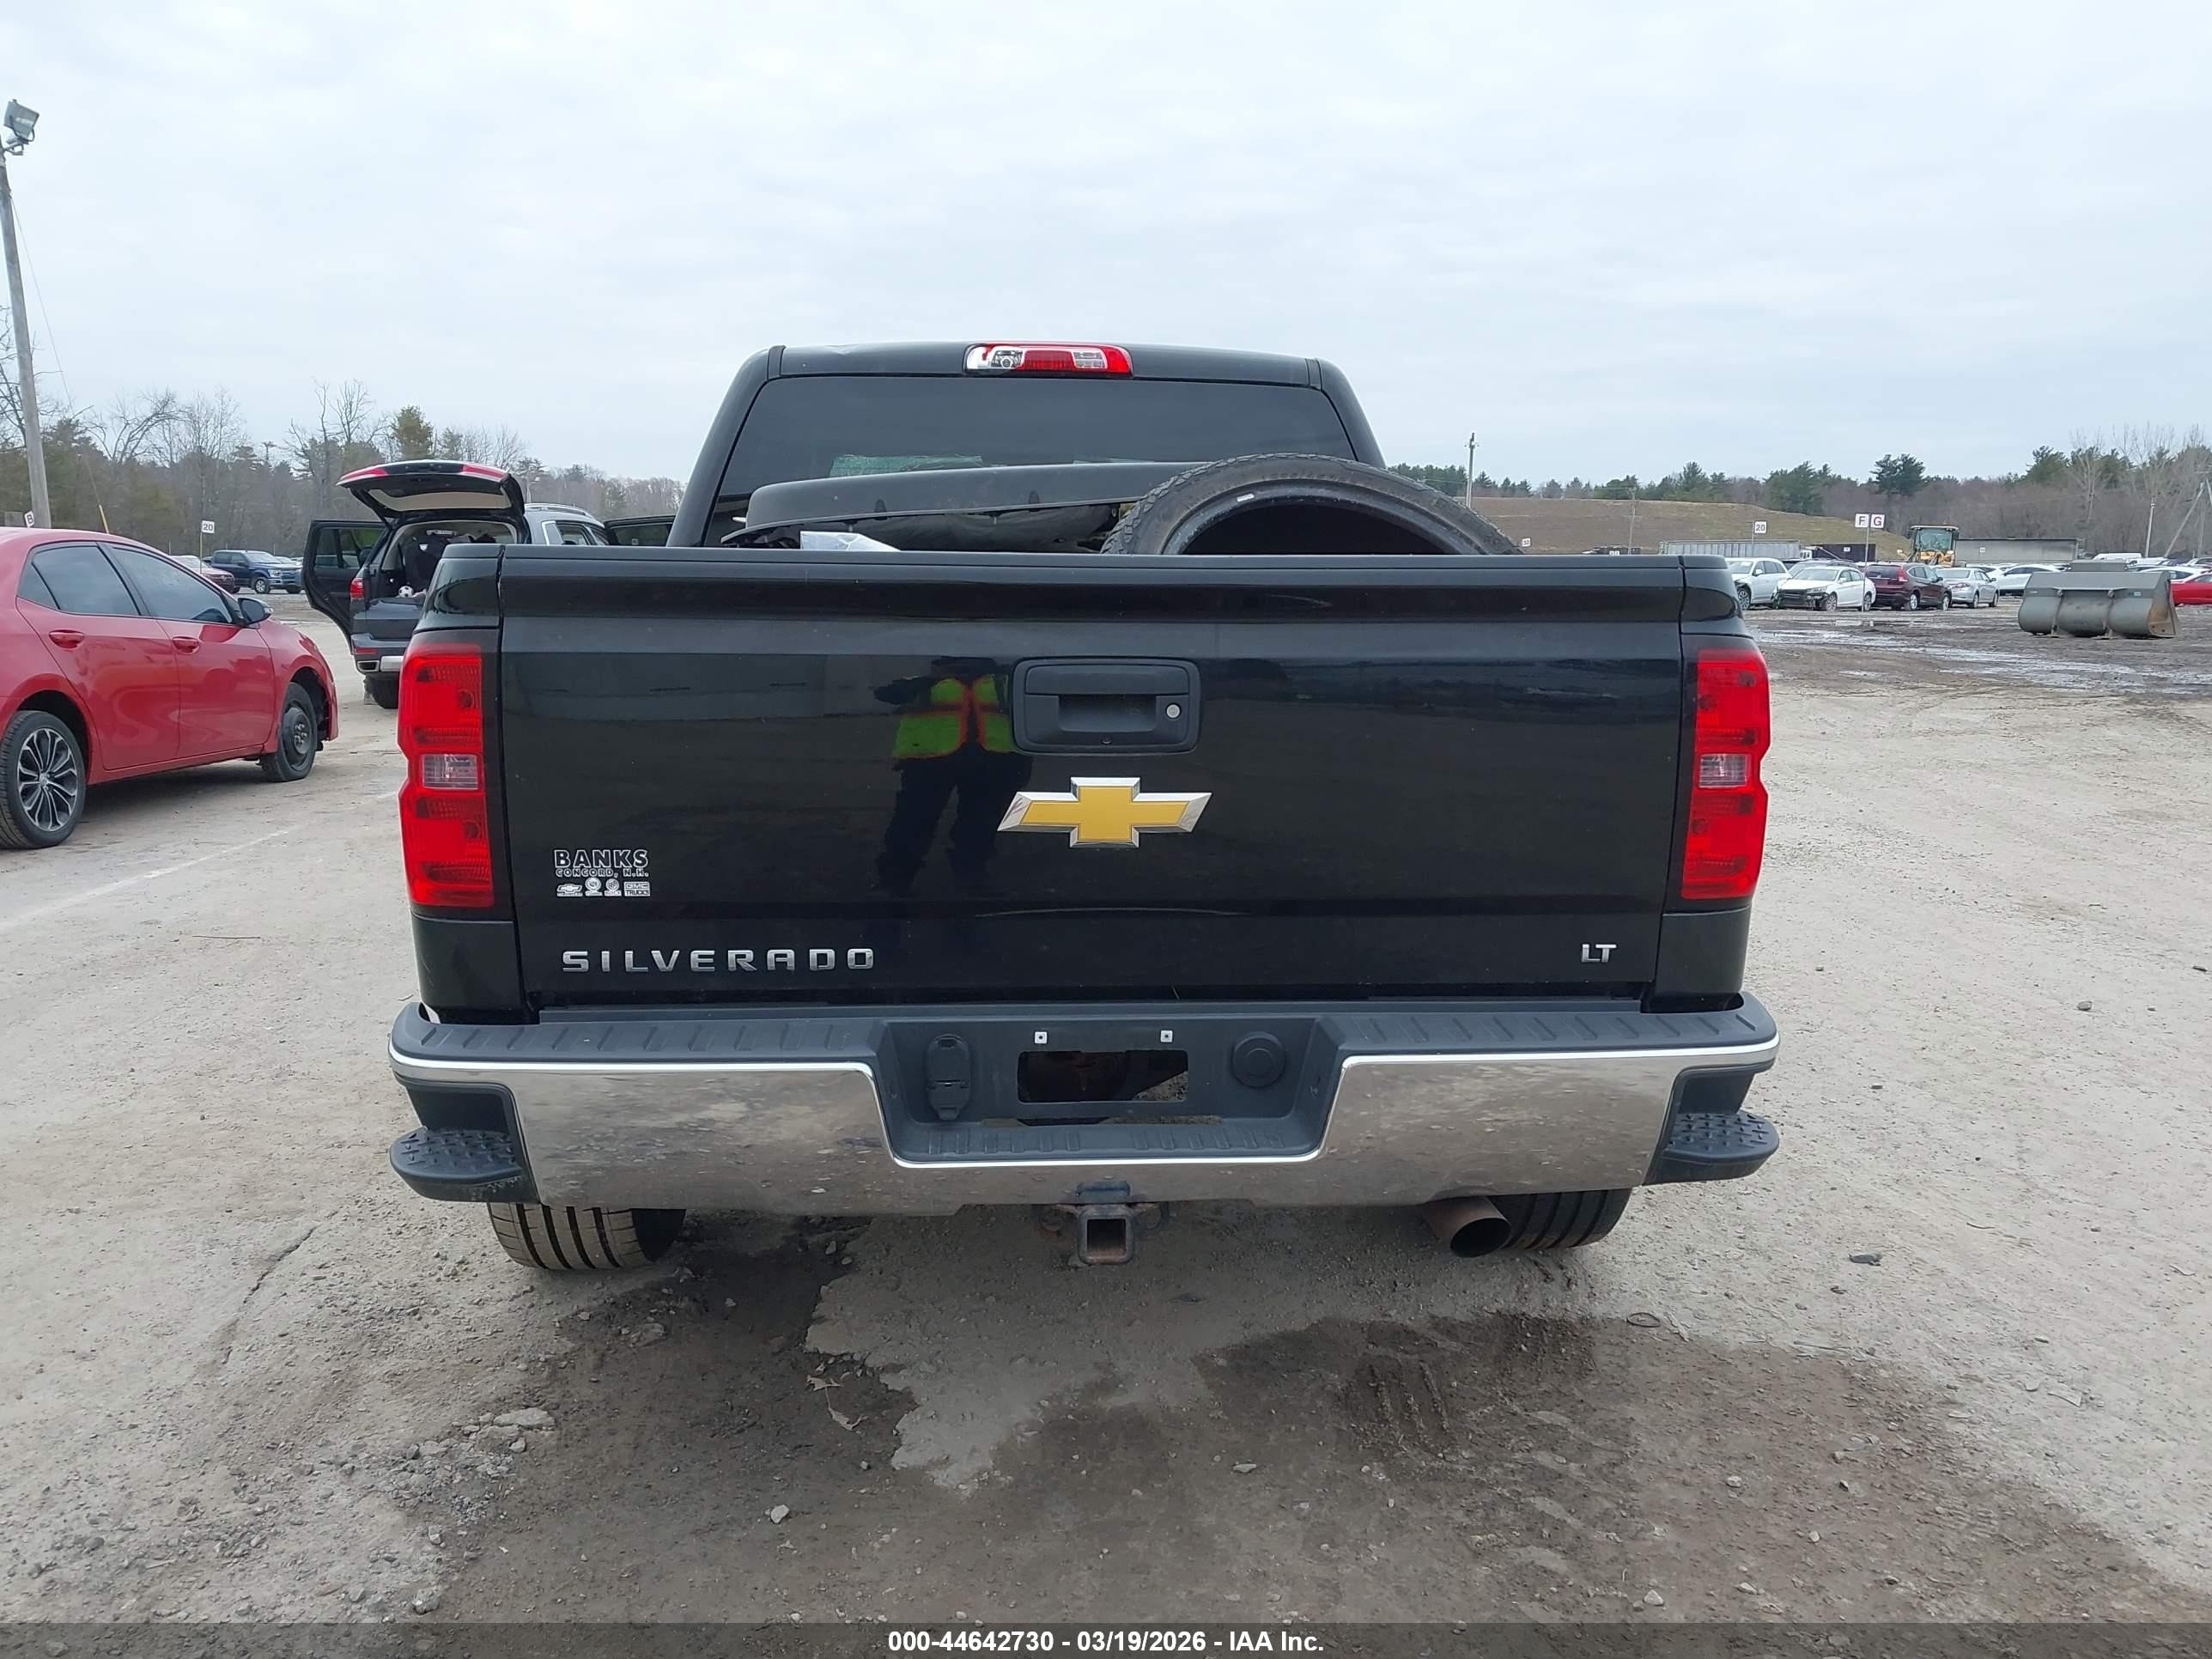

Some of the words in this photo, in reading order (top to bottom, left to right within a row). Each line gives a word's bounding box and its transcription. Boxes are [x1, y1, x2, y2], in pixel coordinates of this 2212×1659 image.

[1858, 515, 1866, 526] F
[1873, 516, 1882, 526] G
[554, 849, 648, 868] BANKS
[556, 868, 618, 878] CONCORD,
[623, 868, 649, 877] N.H.
[562, 948, 874, 972] SILVERADO
[1581, 944, 1617, 963] LT
